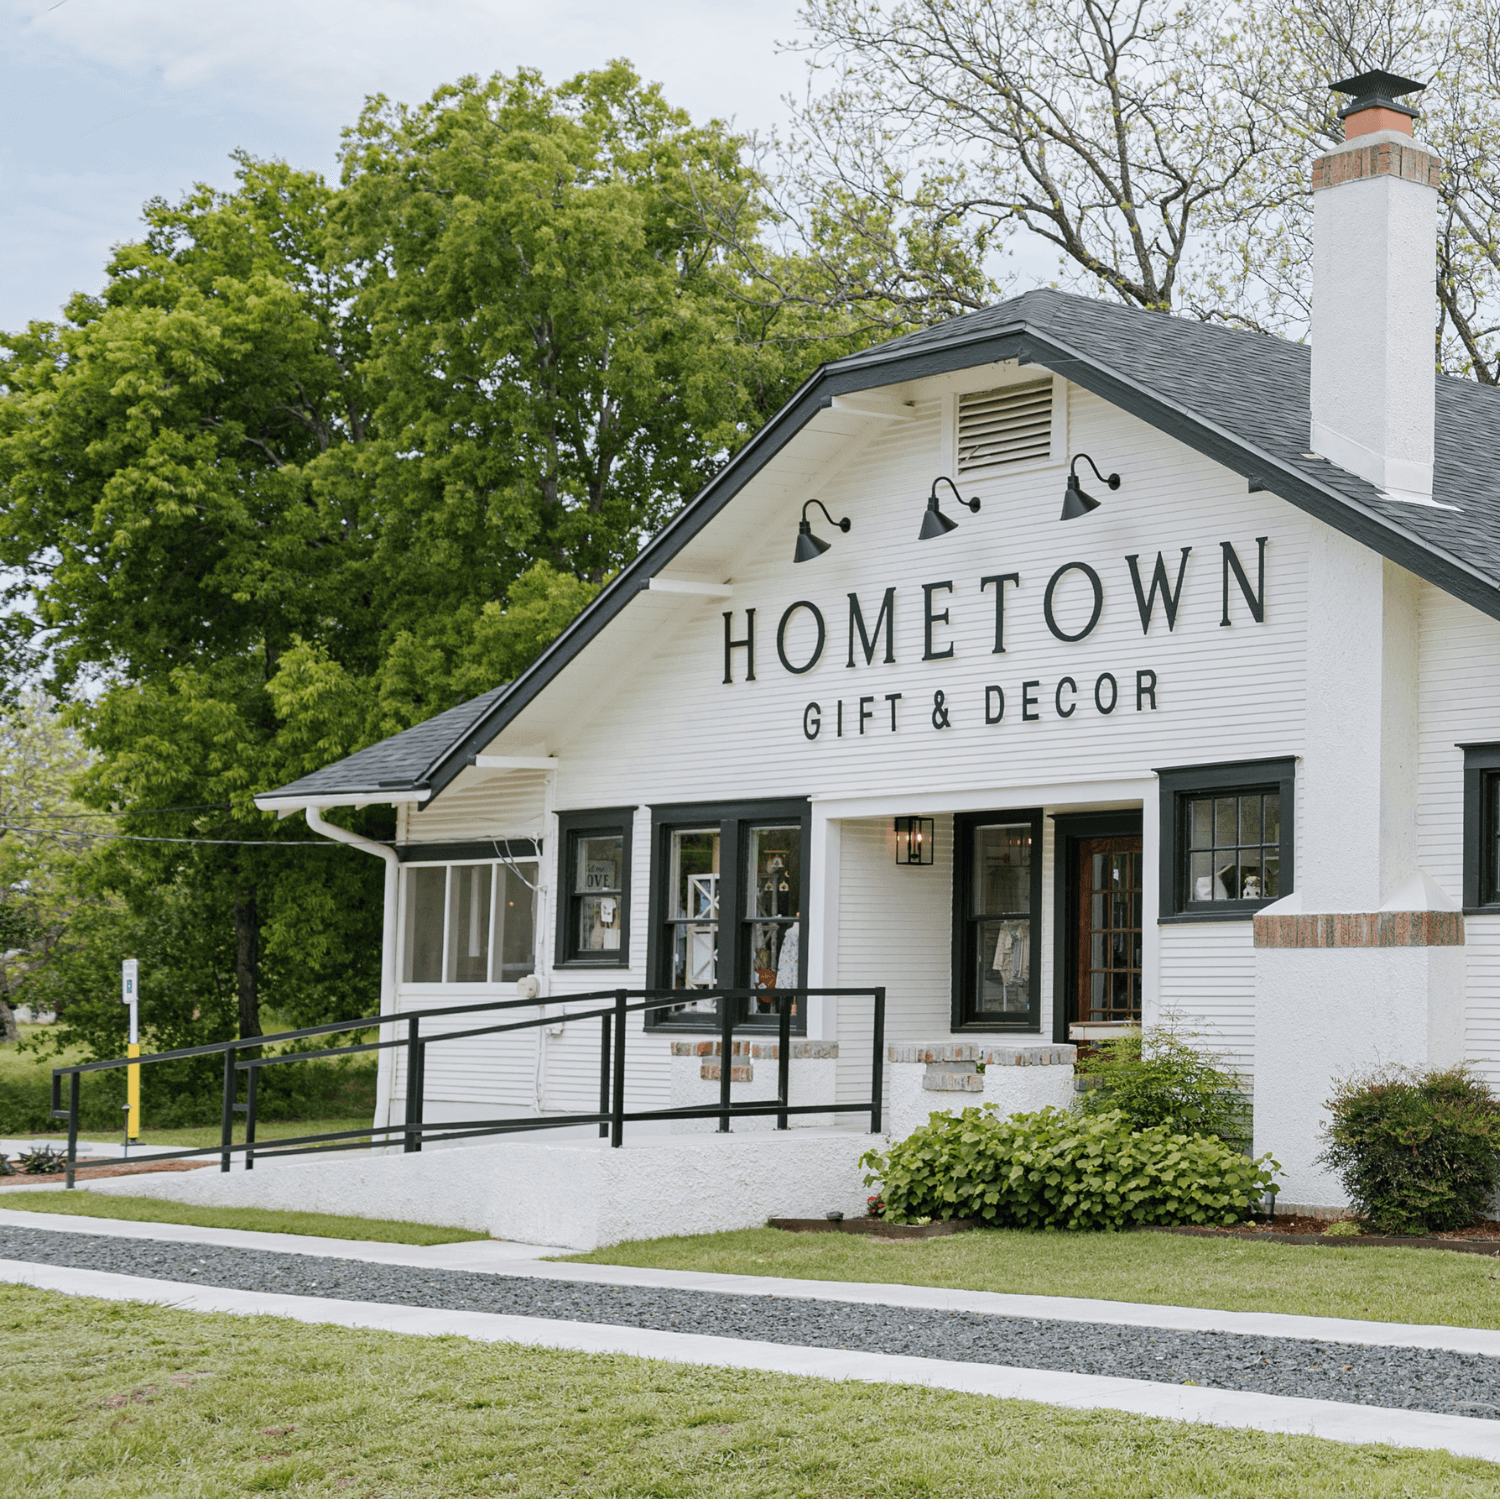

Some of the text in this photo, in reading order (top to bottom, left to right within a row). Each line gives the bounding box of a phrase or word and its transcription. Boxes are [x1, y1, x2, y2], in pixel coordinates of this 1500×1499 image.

[722, 536, 1269, 685] HOMETOWN
[803, 669, 1158, 741] GIFT & DECOR
[587, 874, 609, 888] OVE
